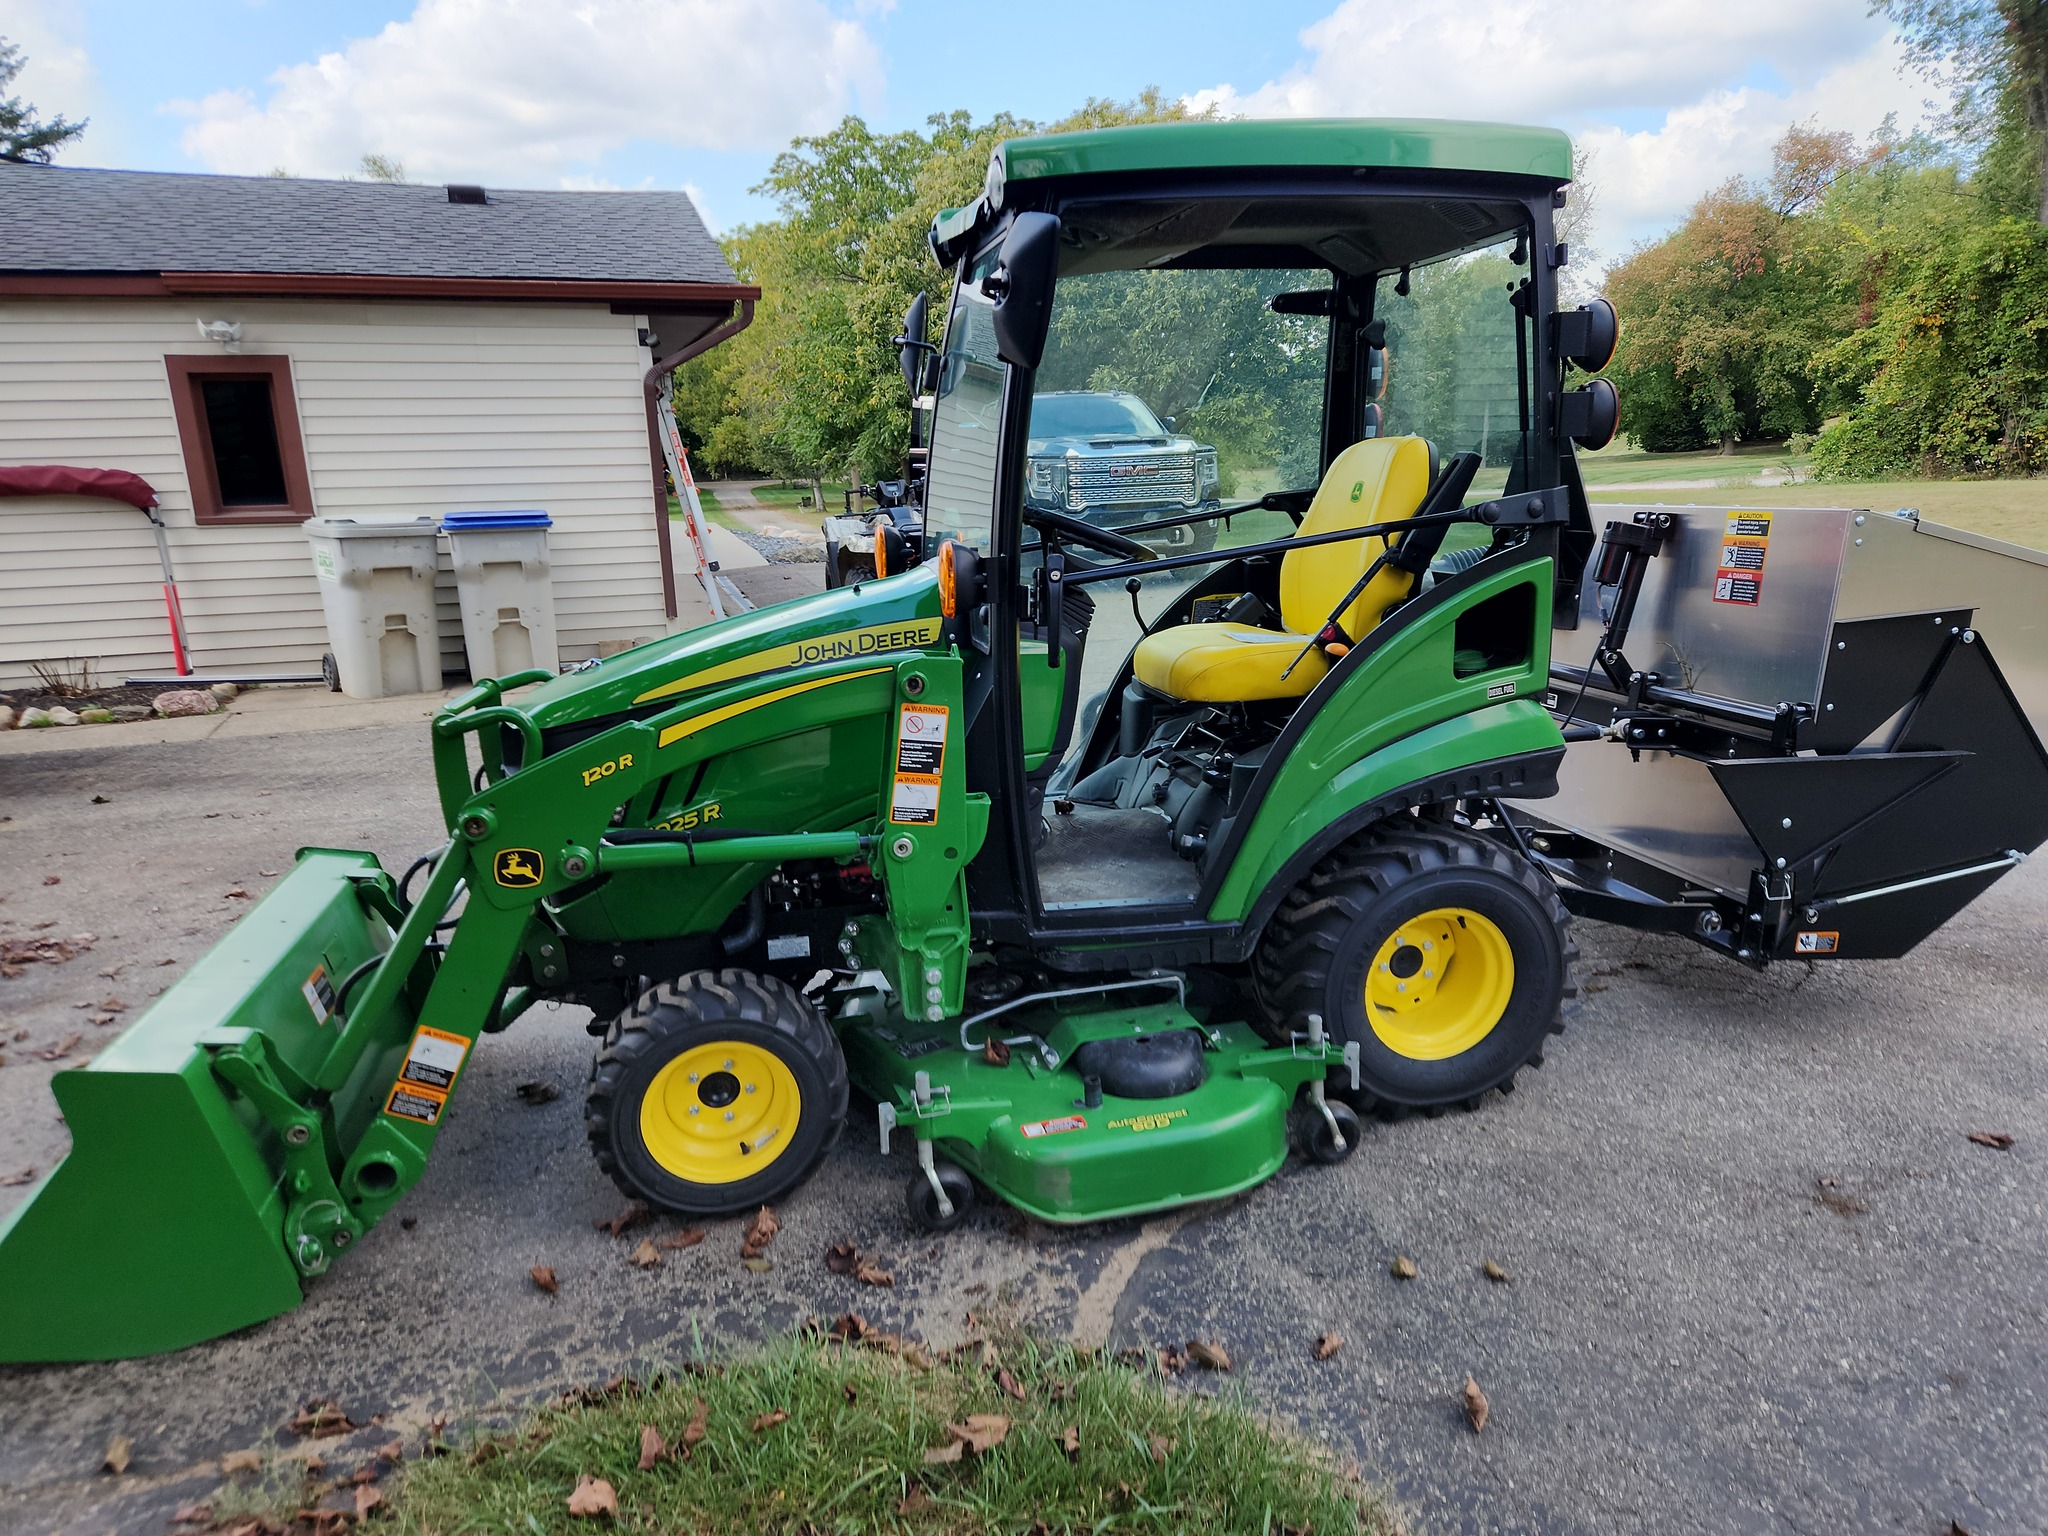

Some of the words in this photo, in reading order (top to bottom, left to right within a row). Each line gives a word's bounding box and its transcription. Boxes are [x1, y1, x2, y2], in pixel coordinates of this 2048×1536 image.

[1110, 464, 1159, 477] GMC
[790, 639, 853, 664] JOHN
[858, 628, 931, 652] DEERE
[1489, 687, 1503, 697] DIESEL
[1503, 685, 1515, 694] FUEL
[911, 706, 946, 714] WARNING
[582, 761, 616, 787] 120
[619, 753, 634, 770] R
[904, 776, 938, 784] WARNING
[649, 811, 699, 831] 025
[703, 803, 720, 823] R
